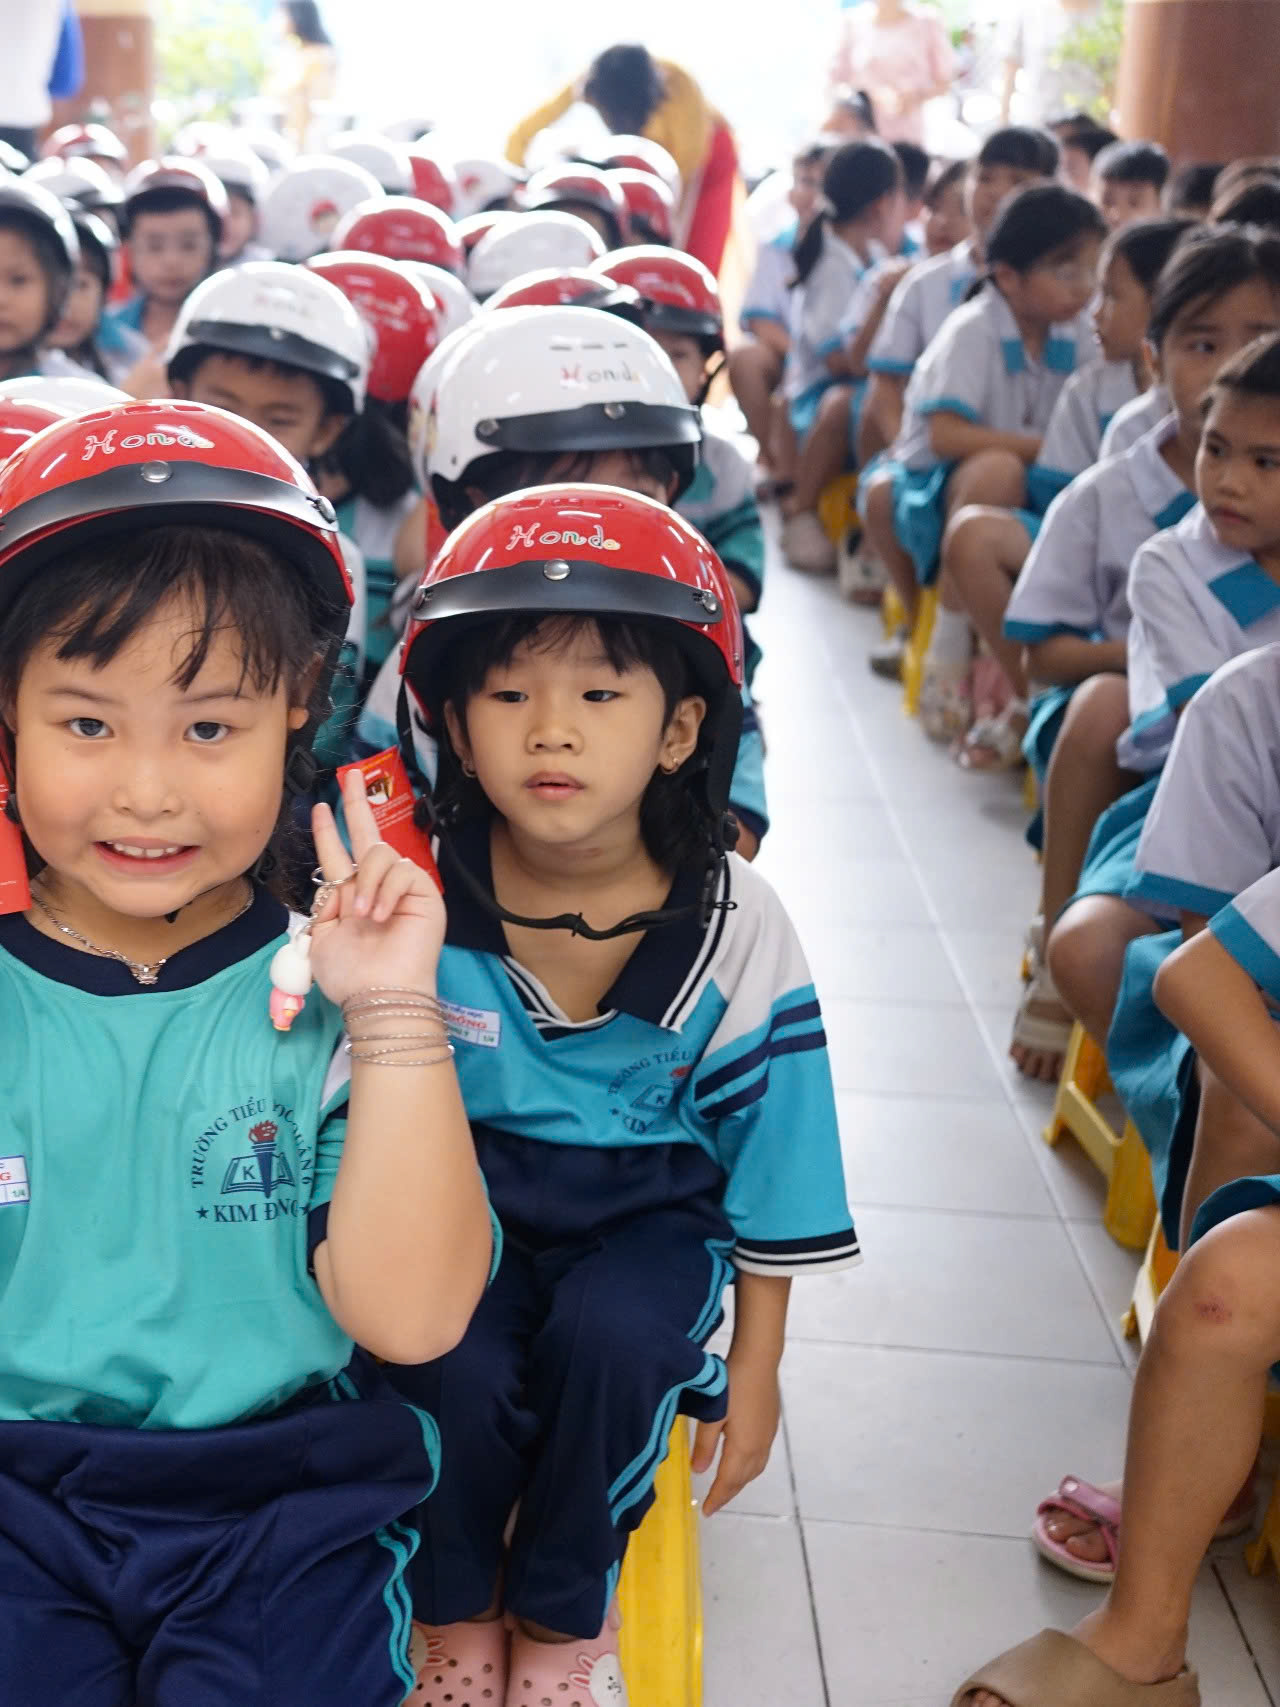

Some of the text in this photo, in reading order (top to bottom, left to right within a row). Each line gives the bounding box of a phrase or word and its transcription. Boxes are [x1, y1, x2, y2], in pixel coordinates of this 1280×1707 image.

[81, 423, 216, 461] Honda
[505, 522, 621, 551] Honda
[192, 1117, 229, 1188] TRƯỜNG
[228, 1096, 266, 1121] TIỂU
[243, 1165, 256, 1180] K
[213, 1198, 298, 1222] KIM ĐNG
